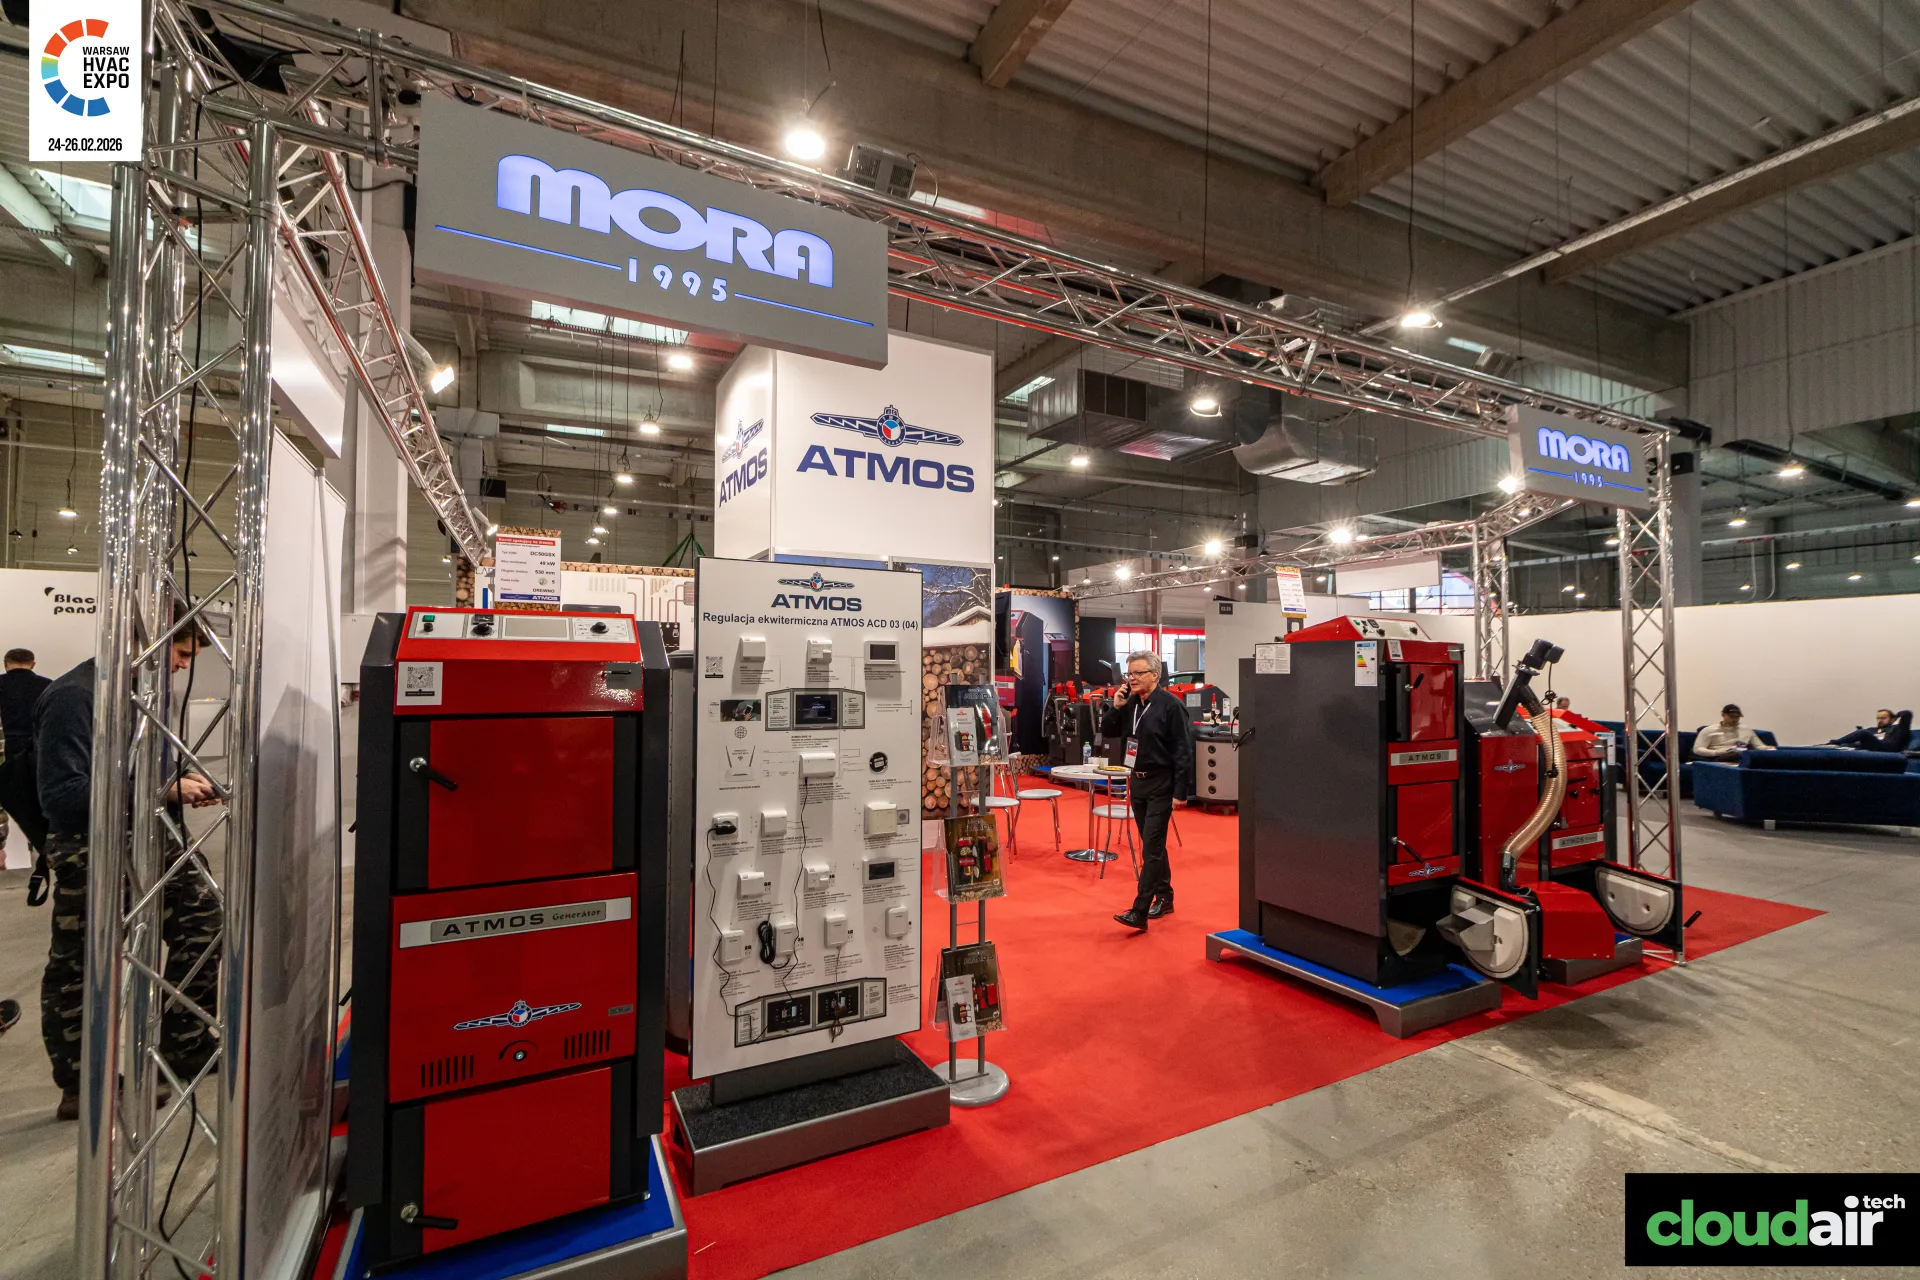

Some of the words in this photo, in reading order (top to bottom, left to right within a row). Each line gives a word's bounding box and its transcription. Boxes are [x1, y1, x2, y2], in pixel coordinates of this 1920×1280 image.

[496, 154, 834, 289] MORA
[627, 257, 728, 303] 1995
[1537, 426, 1631, 474] MORA
[719, 447, 768, 508] ATMOS
[796, 444, 975, 493] ATMOS
[1573, 470, 1603, 488] 1995
[53, 604, 97, 615] pand
[54, 594, 98, 604] Blac
[770, 593, 863, 612] ATMOS
[703, 612, 755, 626] Regulacja
[757, 614, 828, 627] ekwitermiczna
[830, 617, 865, 628] ATMOS
[866, 618, 887, 628] ACD
[889, 619, 900, 629] 03
[902, 620, 919, 631] (04)
[1408, 752, 1442, 761] ATMOS
[442, 912, 545, 937] ATMOS
